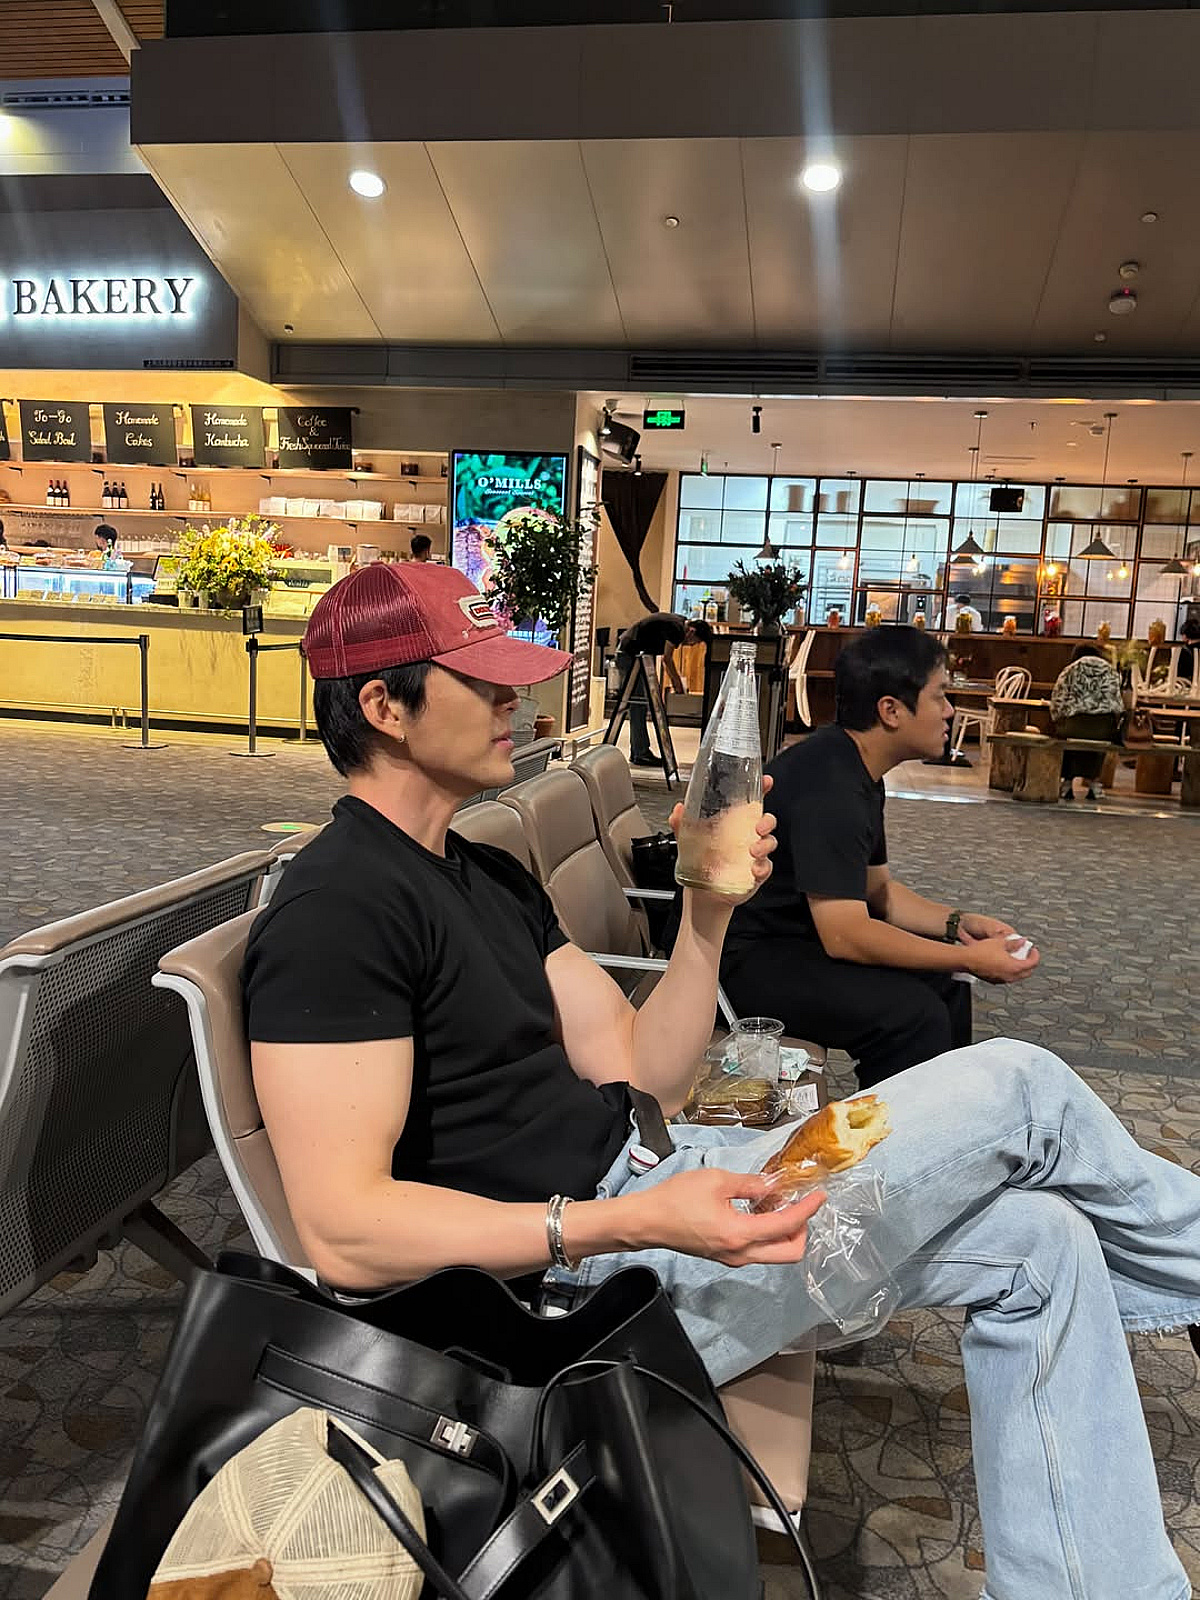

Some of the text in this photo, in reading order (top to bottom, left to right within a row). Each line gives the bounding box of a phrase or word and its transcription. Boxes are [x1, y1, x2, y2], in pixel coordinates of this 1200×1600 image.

[12, 278, 194, 315] BAKERY
[34, 409, 72, 424] To-Go
[115, 411, 160, 425] Homemade
[204, 412, 248, 426] Homemade
[297, 414, 328, 428] Coffee
[28, 430, 52, 445] Salad
[309, 426, 319, 437] &
[125, 432, 153, 447] Cakes
[478, 477, 542, 490] O'MILLS
